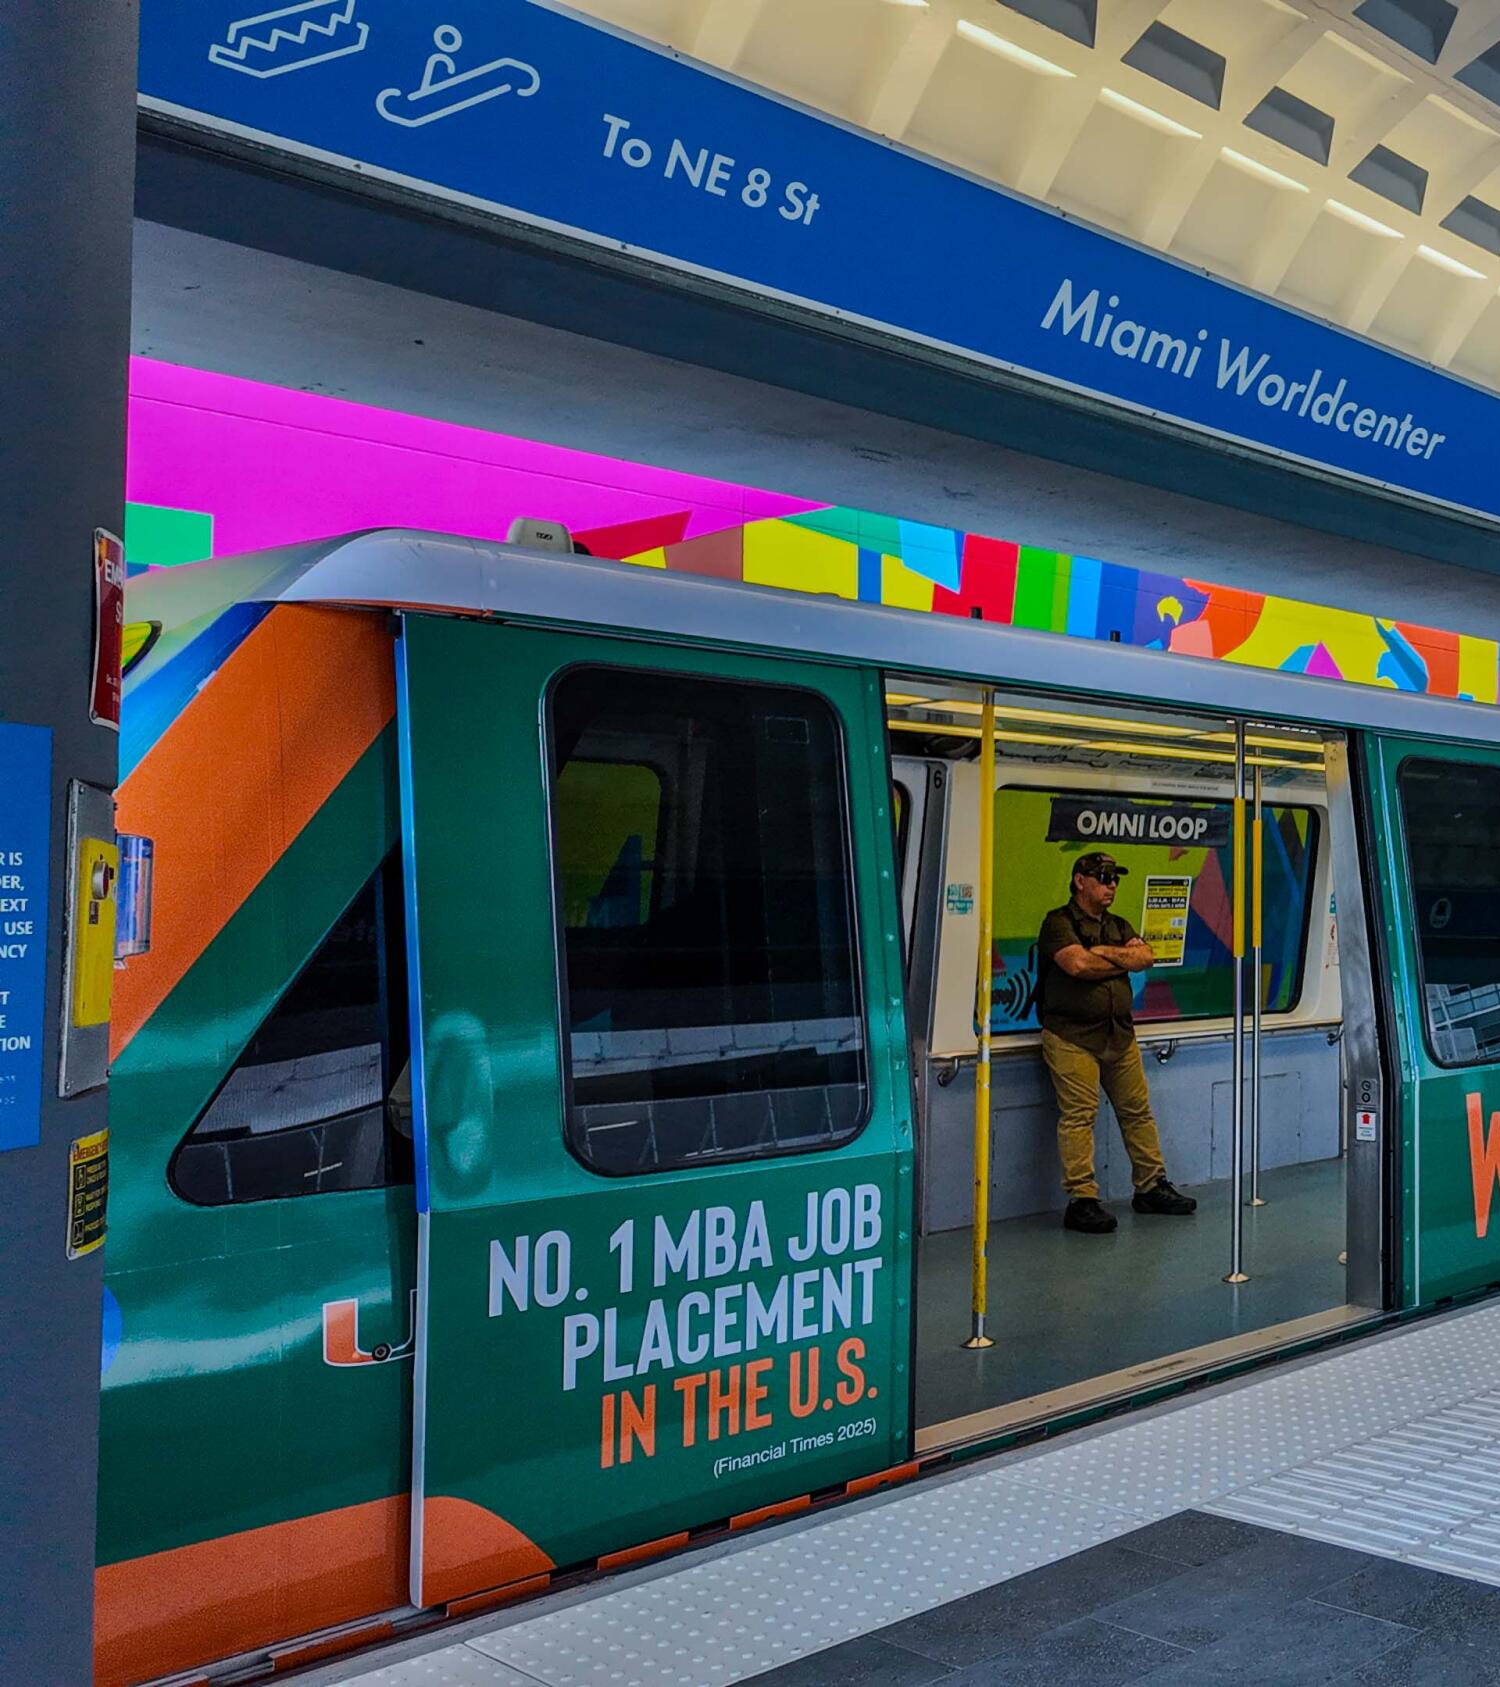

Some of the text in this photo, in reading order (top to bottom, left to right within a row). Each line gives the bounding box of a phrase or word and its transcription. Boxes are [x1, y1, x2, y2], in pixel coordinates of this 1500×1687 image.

[602, 113, 820, 226] To NE 8 St
[1039, 278, 1447, 460] Miami Worldcenter
[934, 769, 943, 789] 6
[1076, 810, 1208, 840] OMNI LOOP
[0, 875, 25, 891] ER,
[9, 852, 23, 866] IS
[4, 920, 33, 936] USE
[488, 1183, 882, 1318] NO. 1 MBA JOB
[562, 1257, 883, 1391] PLACEMENT
[600, 1336, 879, 1470] IN THE U.S.
[713, 1417, 878, 1478] (Financial Times 2025)
